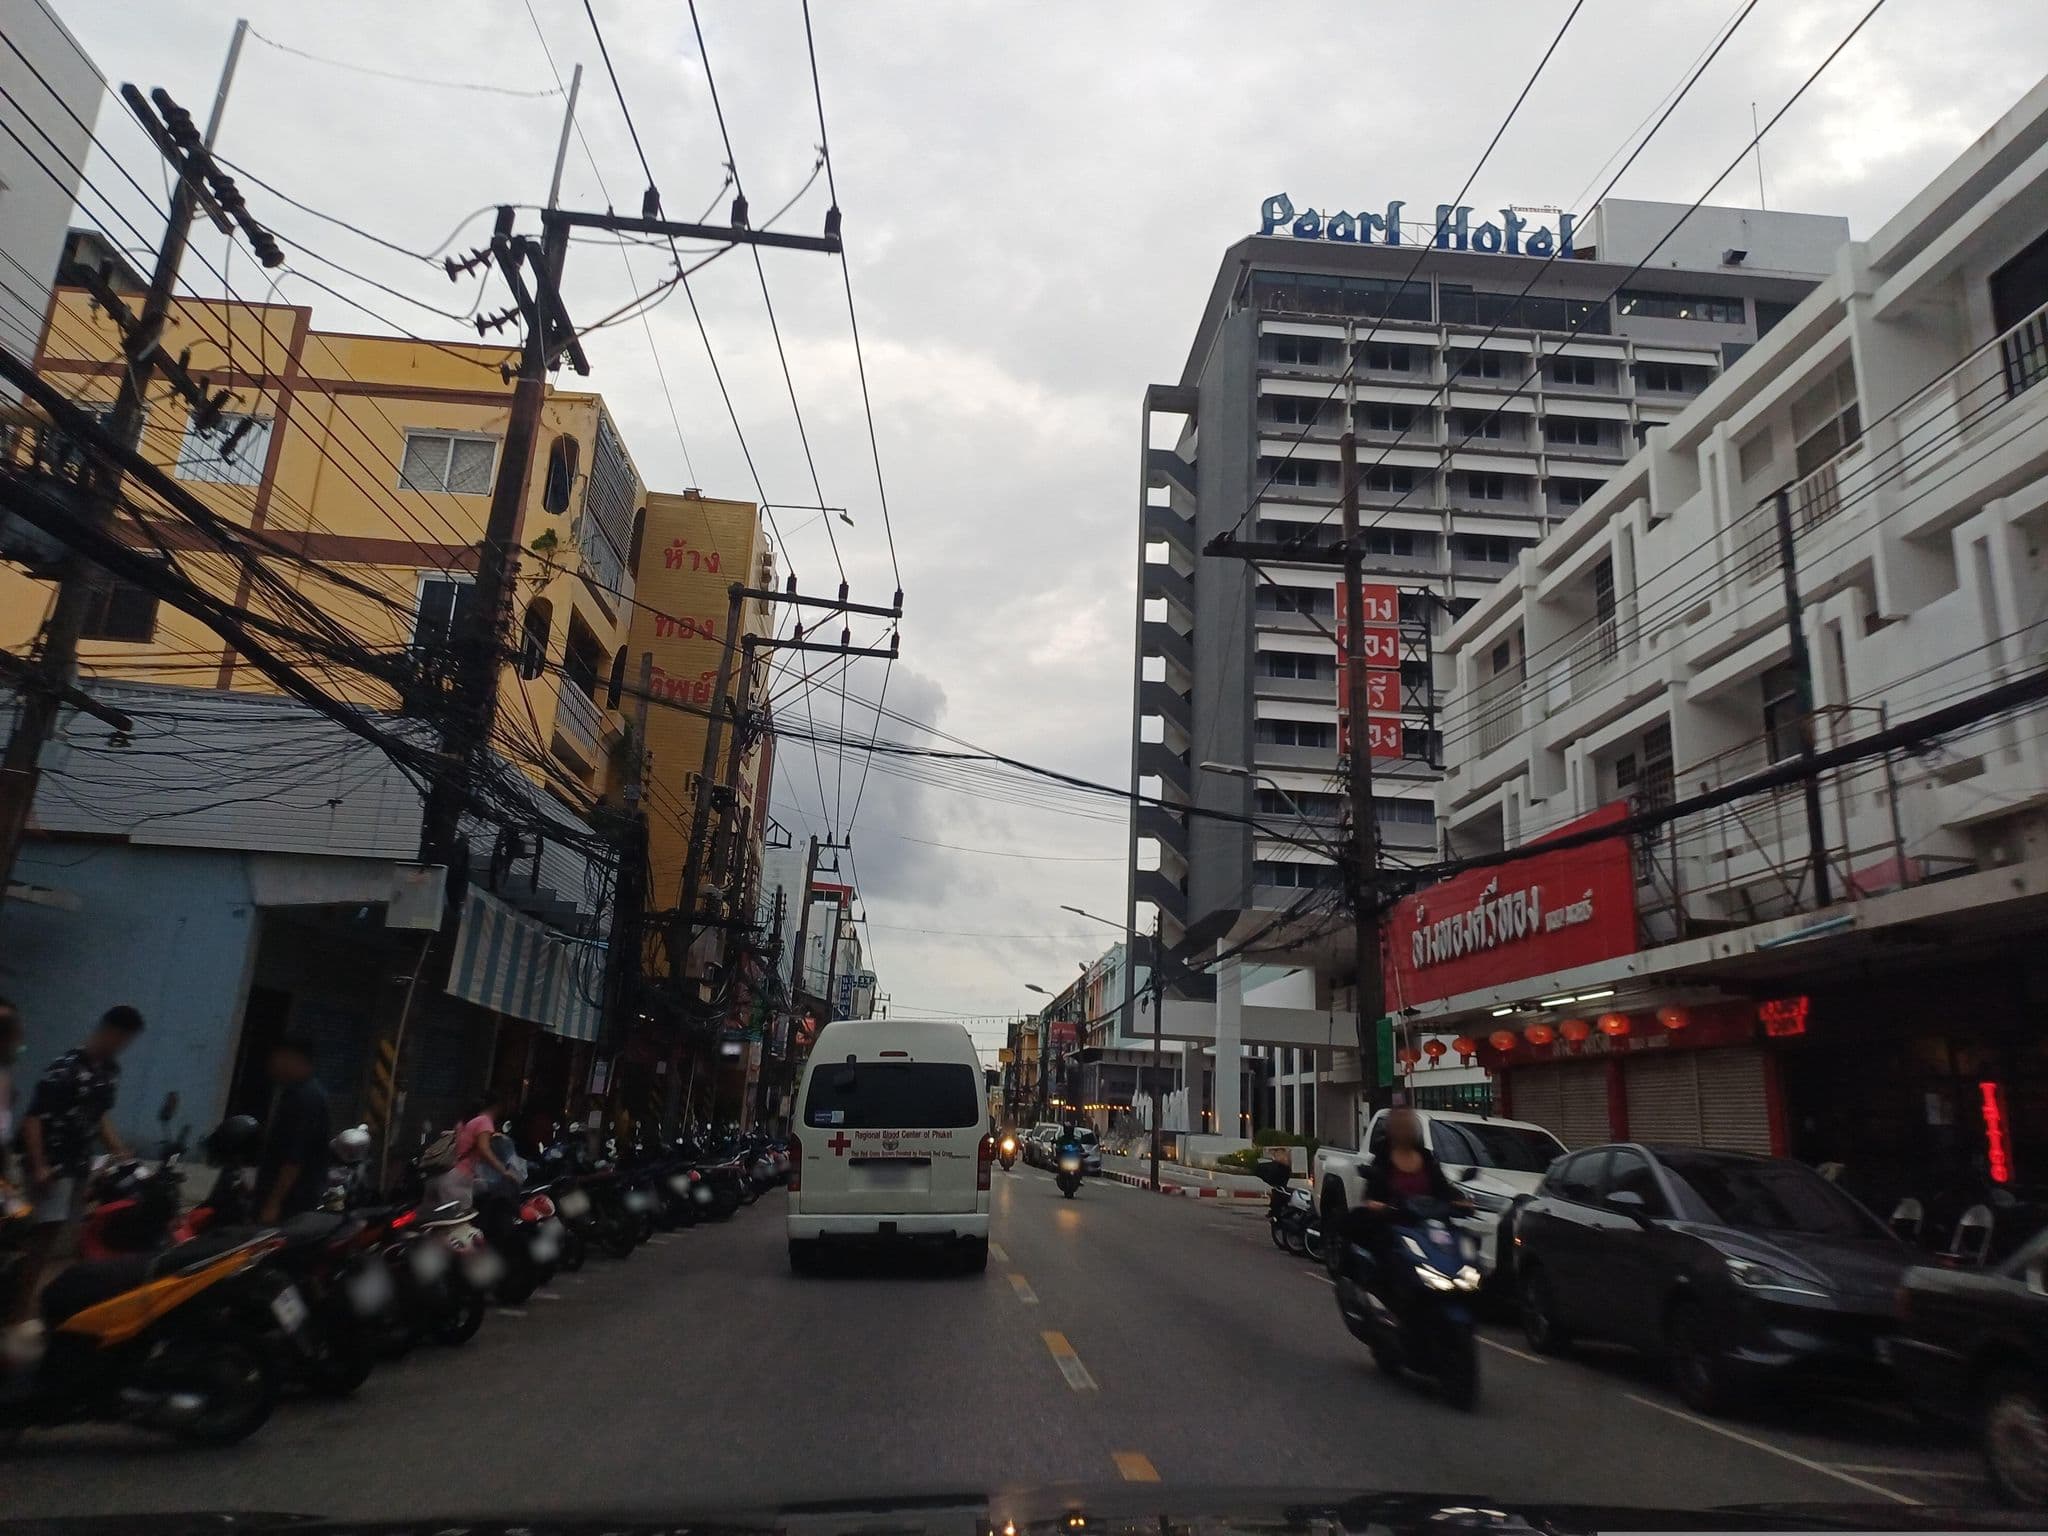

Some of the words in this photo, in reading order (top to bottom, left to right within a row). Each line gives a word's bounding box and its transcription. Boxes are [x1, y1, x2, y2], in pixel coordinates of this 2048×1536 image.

[1257, 192, 1406, 247] Pearl
[1435, 203, 1578, 259] Hotel
[663, 537, 721, 574] ห้าง
[654, 612, 717, 641] ทอง
[854, 1130, 880, 1141] Regional
[882, 1130, 900, 1139] Blood
[901, 1130, 921, 1139] Center
[923, 1130, 931, 1139] of
[932, 1130, 953, 1139] Phuket
